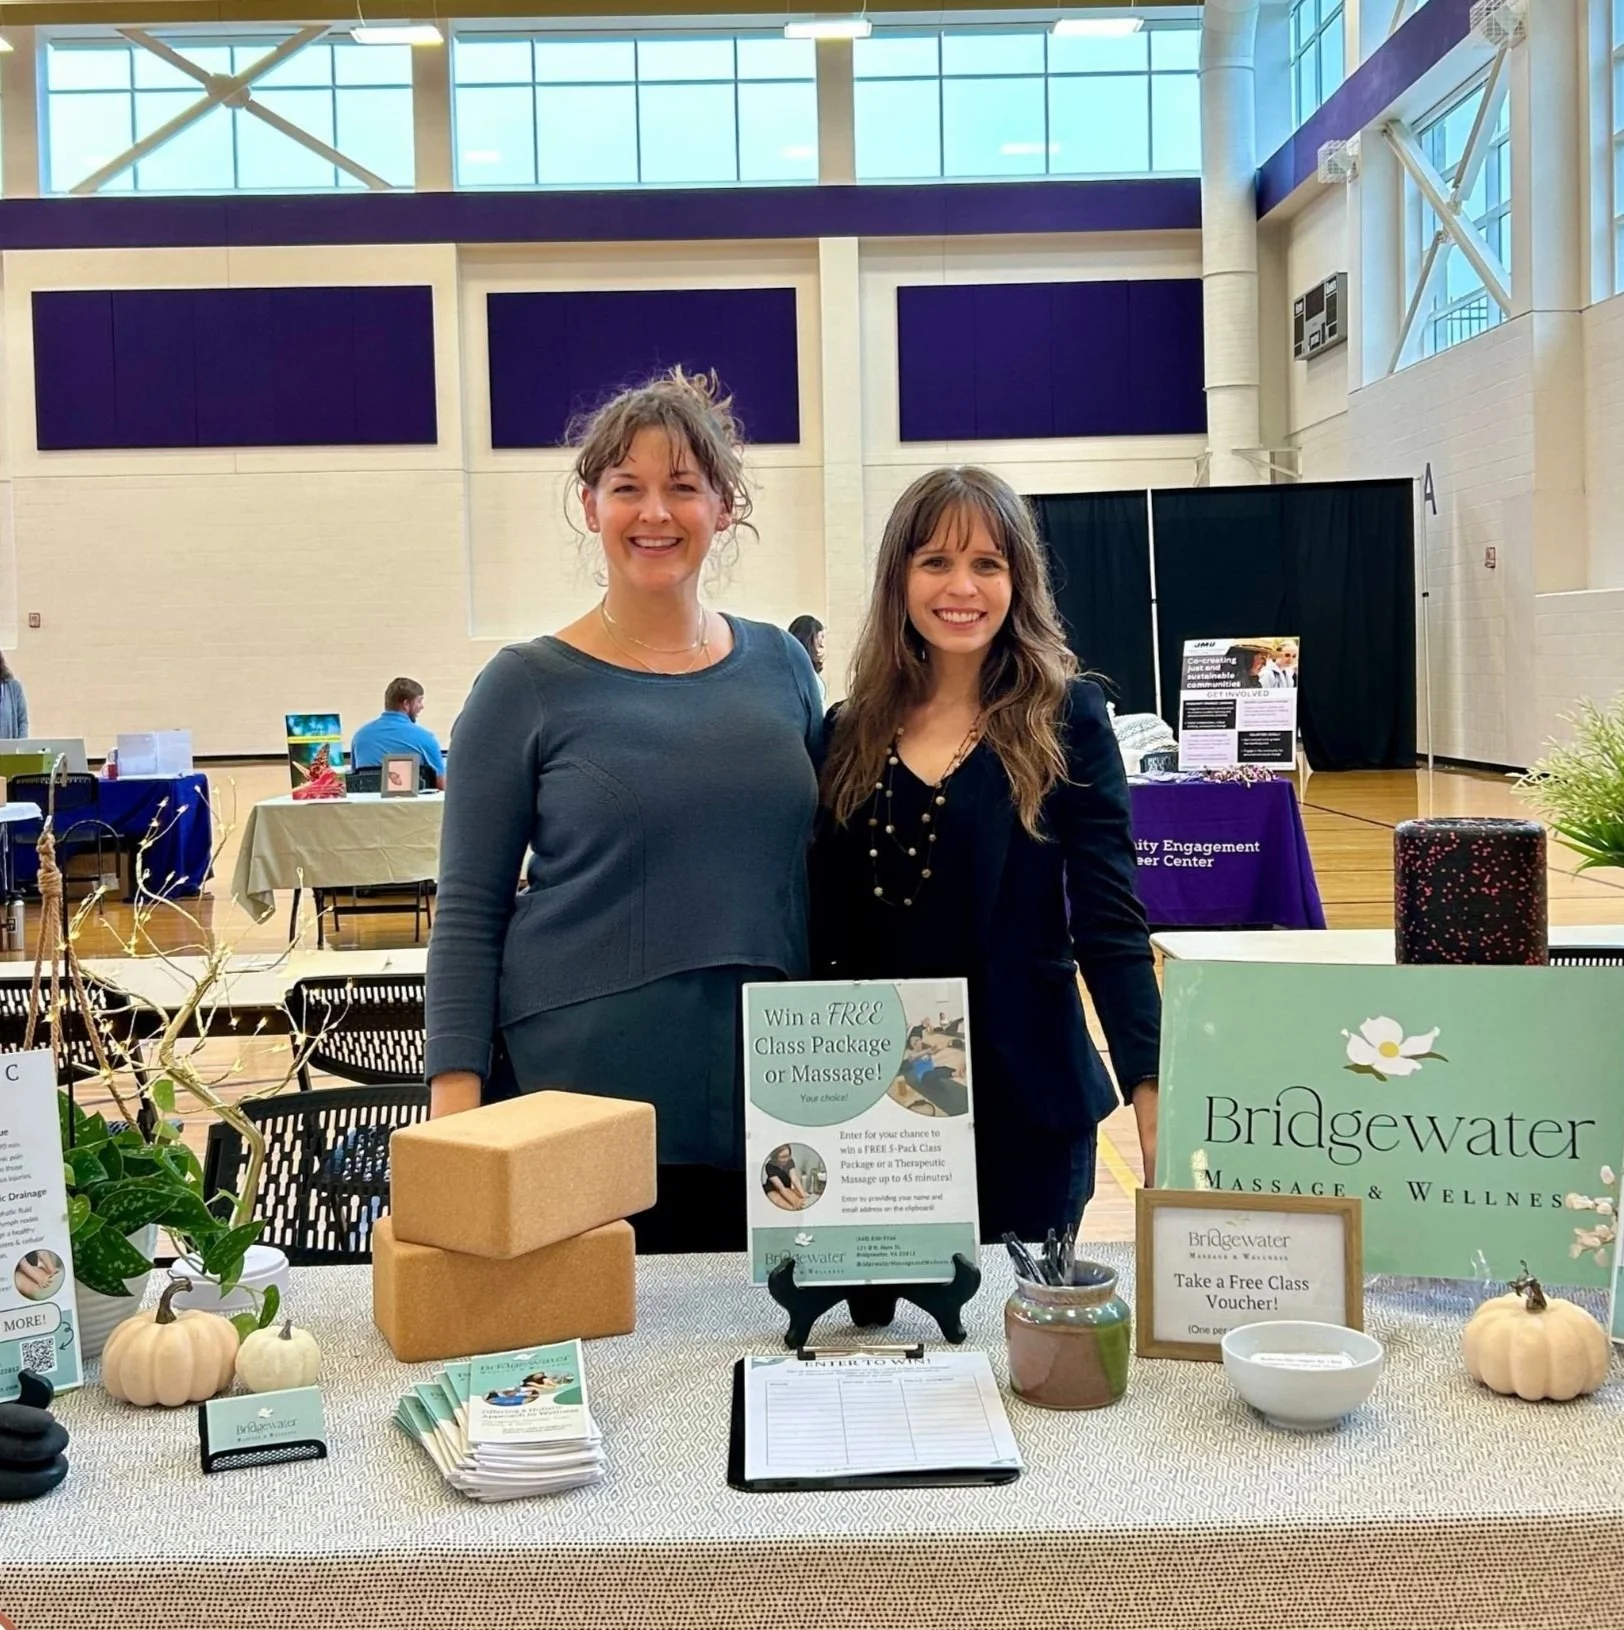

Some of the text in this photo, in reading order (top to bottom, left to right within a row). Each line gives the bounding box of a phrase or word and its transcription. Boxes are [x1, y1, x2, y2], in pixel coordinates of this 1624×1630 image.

[1187, 657, 1237, 665] Co-creating
[1187, 664, 1204, 673] just
[1187, 672, 1235, 680] sustainable
[1225, 690, 1270, 698] INVOLVED
[1163, 840, 1260, 855] Engagement
[1163, 855, 1215, 867] Center
[763, 1001, 884, 1026] Win a FREE
[754, 1035, 892, 1056] Class Package
[5, 1064, 19, 1081] C
[765, 1063, 882, 1085] or Massage!
[800, 1093, 848, 1103] Your choice!
[1205, 1086, 1596, 1166] Bridgewater
[840, 1131, 862, 1140] Enter
[864, 1130, 877, 1139] for
[879, 1131, 897, 1141] your
[900, 1129, 929, 1138] chance
[840, 1145, 855, 1154] win
[857, 1146, 862, 1154] a
[864, 1145, 886, 1154] FREE
[919, 1143, 942, 1152] Class
[841, 1160, 874, 1170] Package
[894, 1159, 945, 1169] Therapeutic
[841, 1172, 953, 1185] Massage up to 45 minutes!
[8, 1189, 47, 1201] Drainage
[1203, 1169, 1564, 1209] MASSAGE & WELLNES
[1188, 1228, 1291, 1251] Bridgewater
[1174, 1273, 1310, 1291] Take a Free Class
[1206, 1294, 1279, 1310] Voucher!
[4, 1315, 46, 1332] MORE!
[1188, 1324, 1210, 1335] (One
[1213, 1327, 1227, 1336] per
[805, 1359, 858, 1368] ENTER
[236, 1418, 298, 1435] Bridgewater
